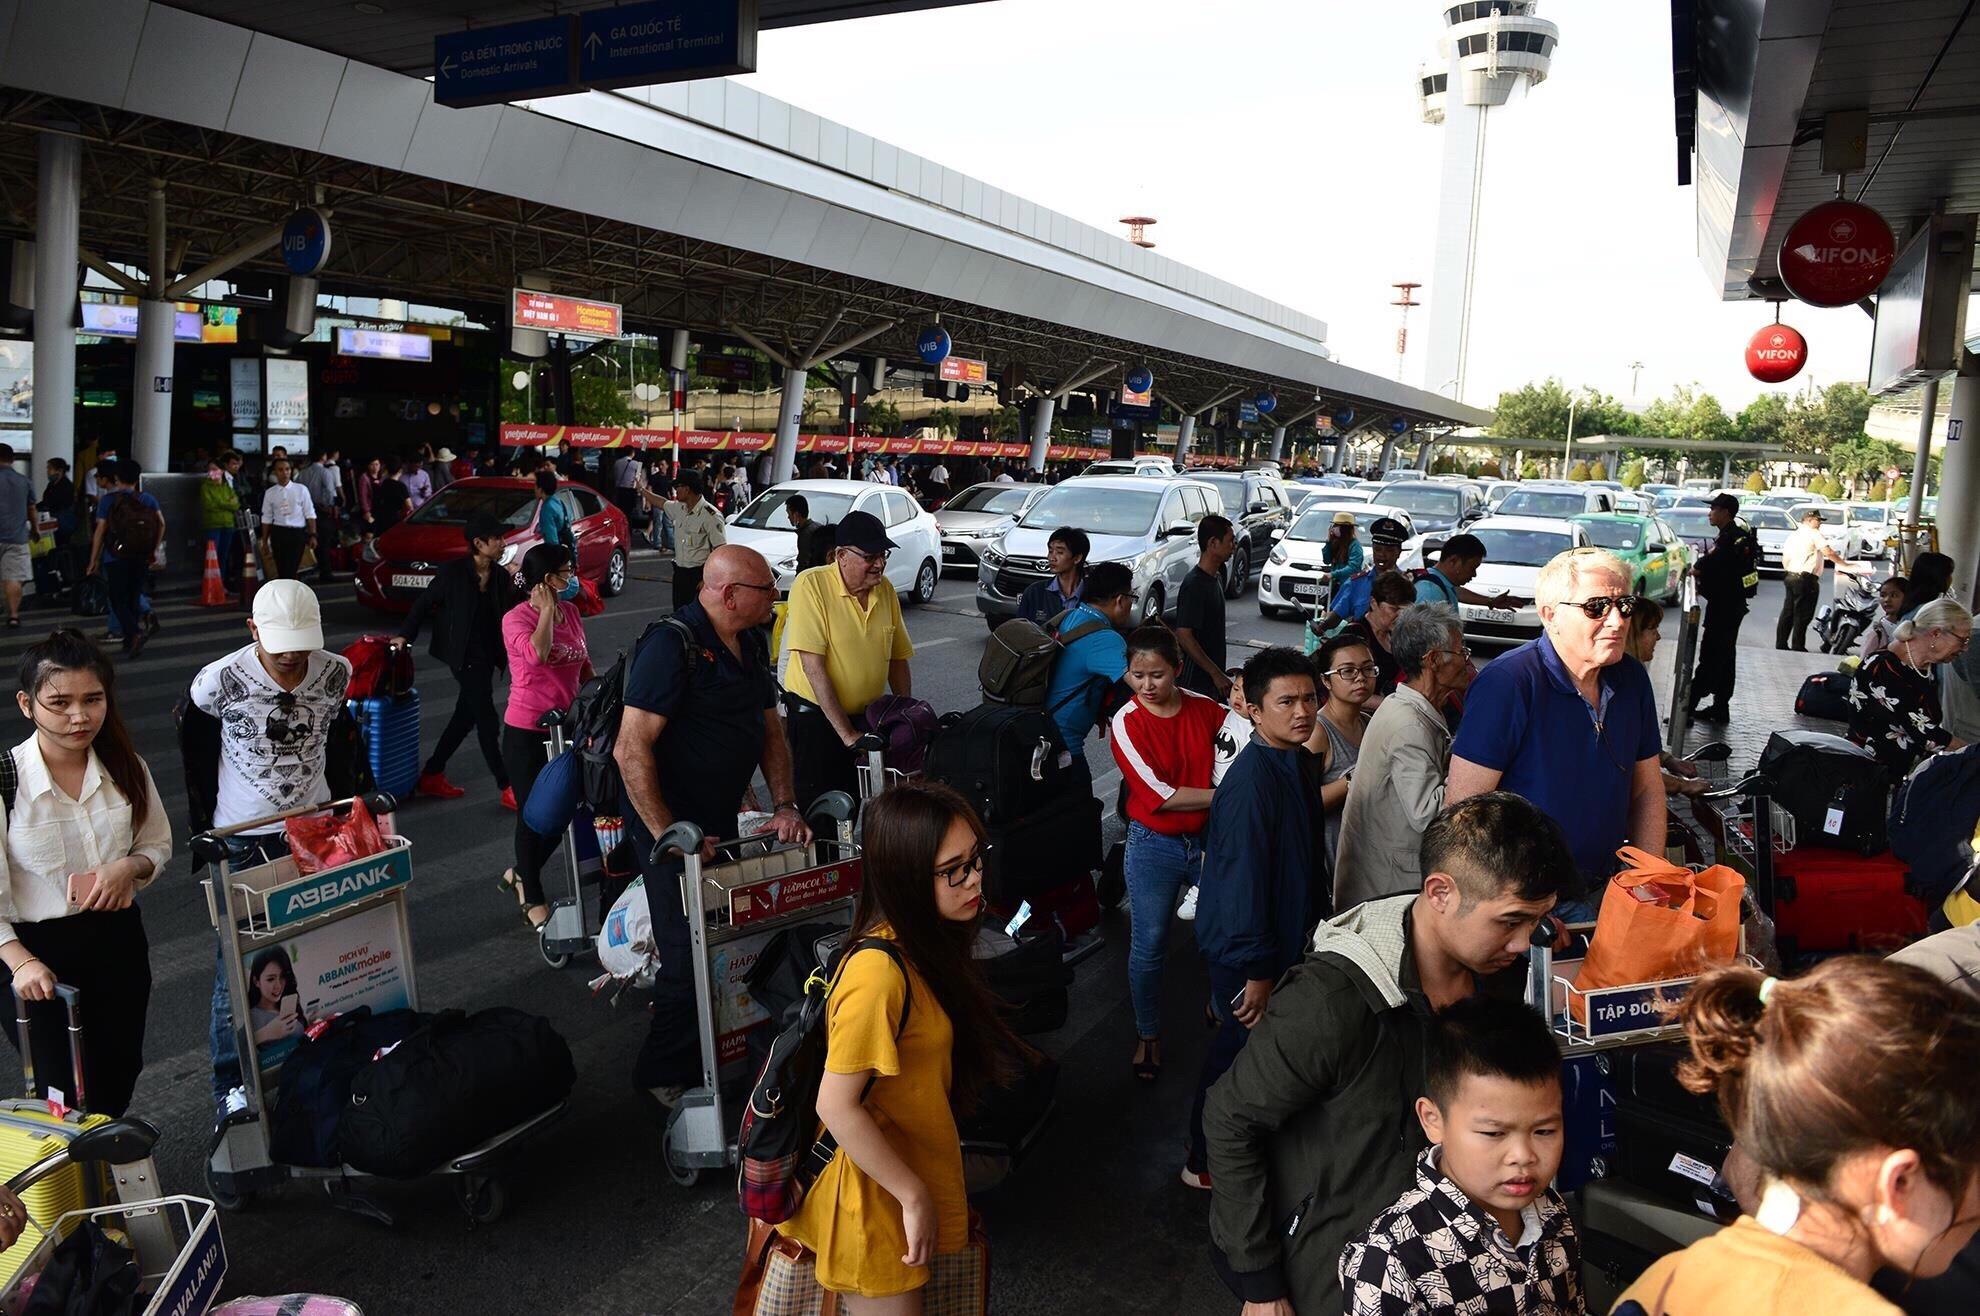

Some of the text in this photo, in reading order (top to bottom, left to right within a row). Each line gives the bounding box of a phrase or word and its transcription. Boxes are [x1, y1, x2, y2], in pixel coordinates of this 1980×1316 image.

[609, 27, 627, 41] GA
[609, 33, 724, 59] International Terminal
[461, 50, 476, 62] GA
[460, 59, 537, 80] Domestic Arrivals
[284, 235, 306, 251] VIB
[919, 341, 938, 353] VIB
[1756, 349, 1798, 361] VIFON
[286, 863, 392, 916] ABBANK
[318, 950, 392, 986] ABBANKmobile
[1597, 1003, 1626, 1023] TẬP
